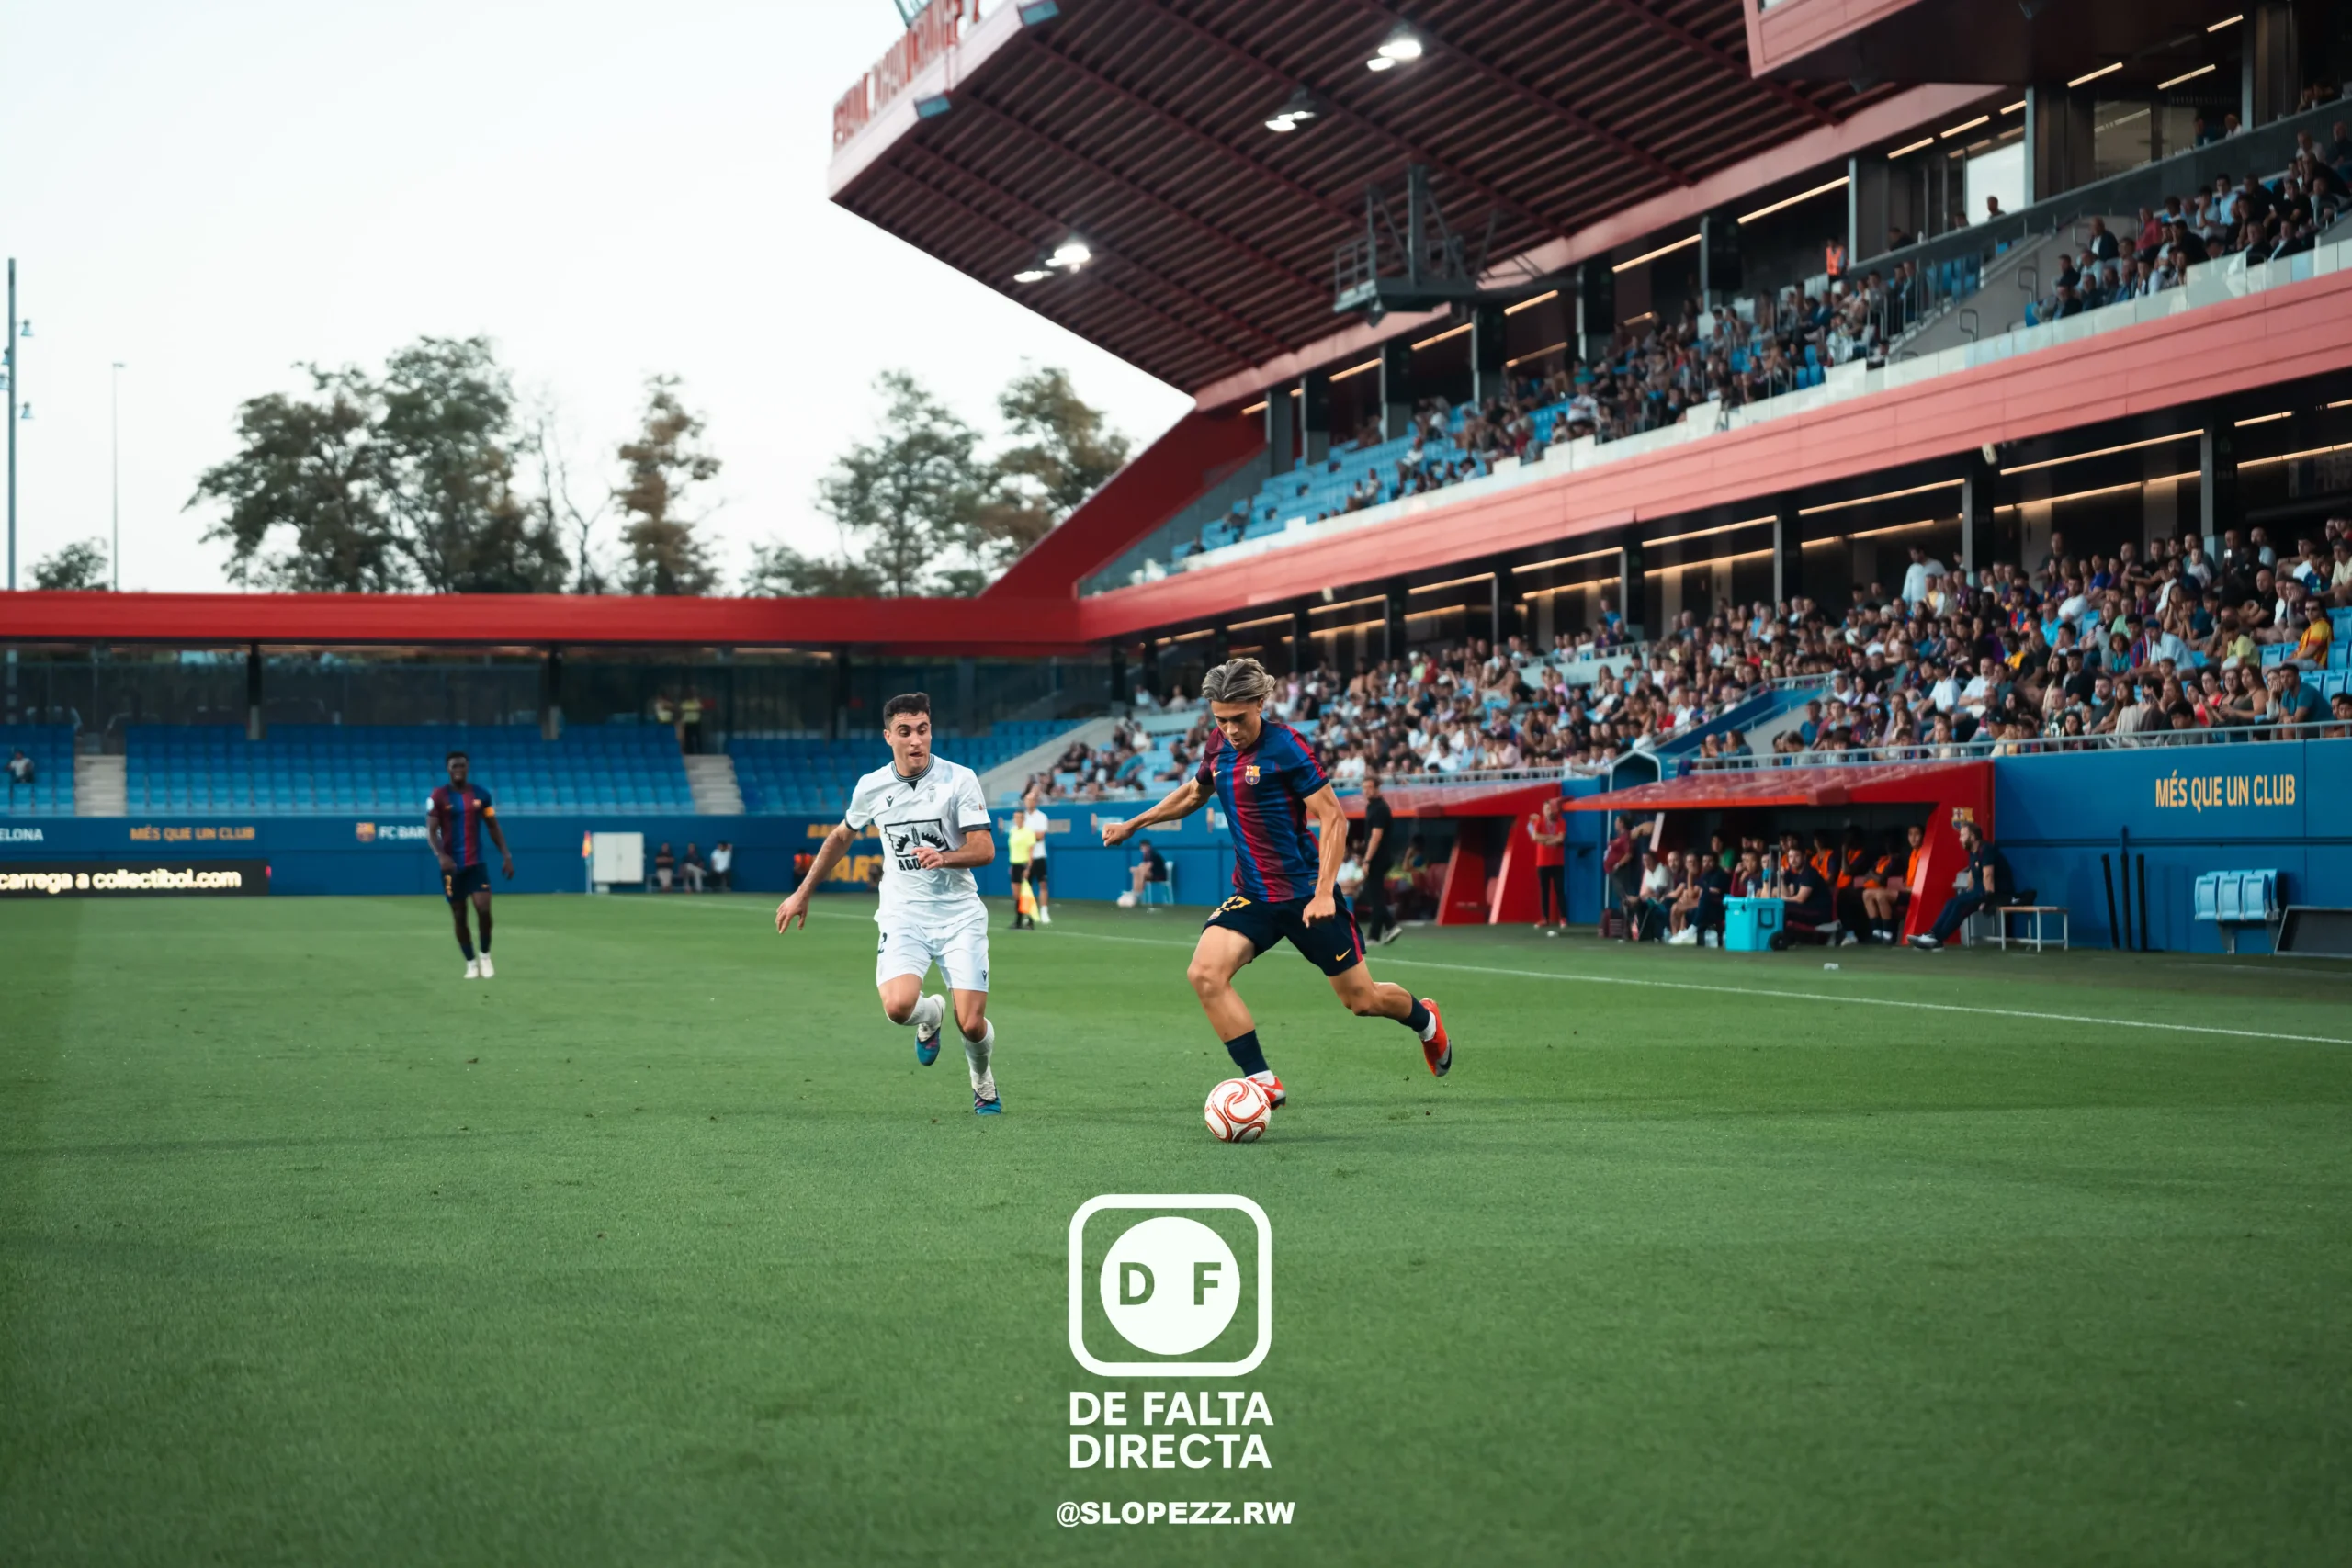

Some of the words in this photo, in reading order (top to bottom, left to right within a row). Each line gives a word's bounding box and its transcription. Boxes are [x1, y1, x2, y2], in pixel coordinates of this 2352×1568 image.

[2155, 769, 2188, 807] MÉS
[2191, 776, 2222, 813] QUE
[2227, 775, 2249, 807] UN
[2254, 774, 2296, 806] CLUB
[164, 827, 192, 841] QUE
[195, 827, 217, 840] UN
[219, 827, 255, 840] CLUB
[899, 858, 922, 871] AGU
[75, 872, 90, 889] a
[92, 868, 242, 889] collectibol.com
